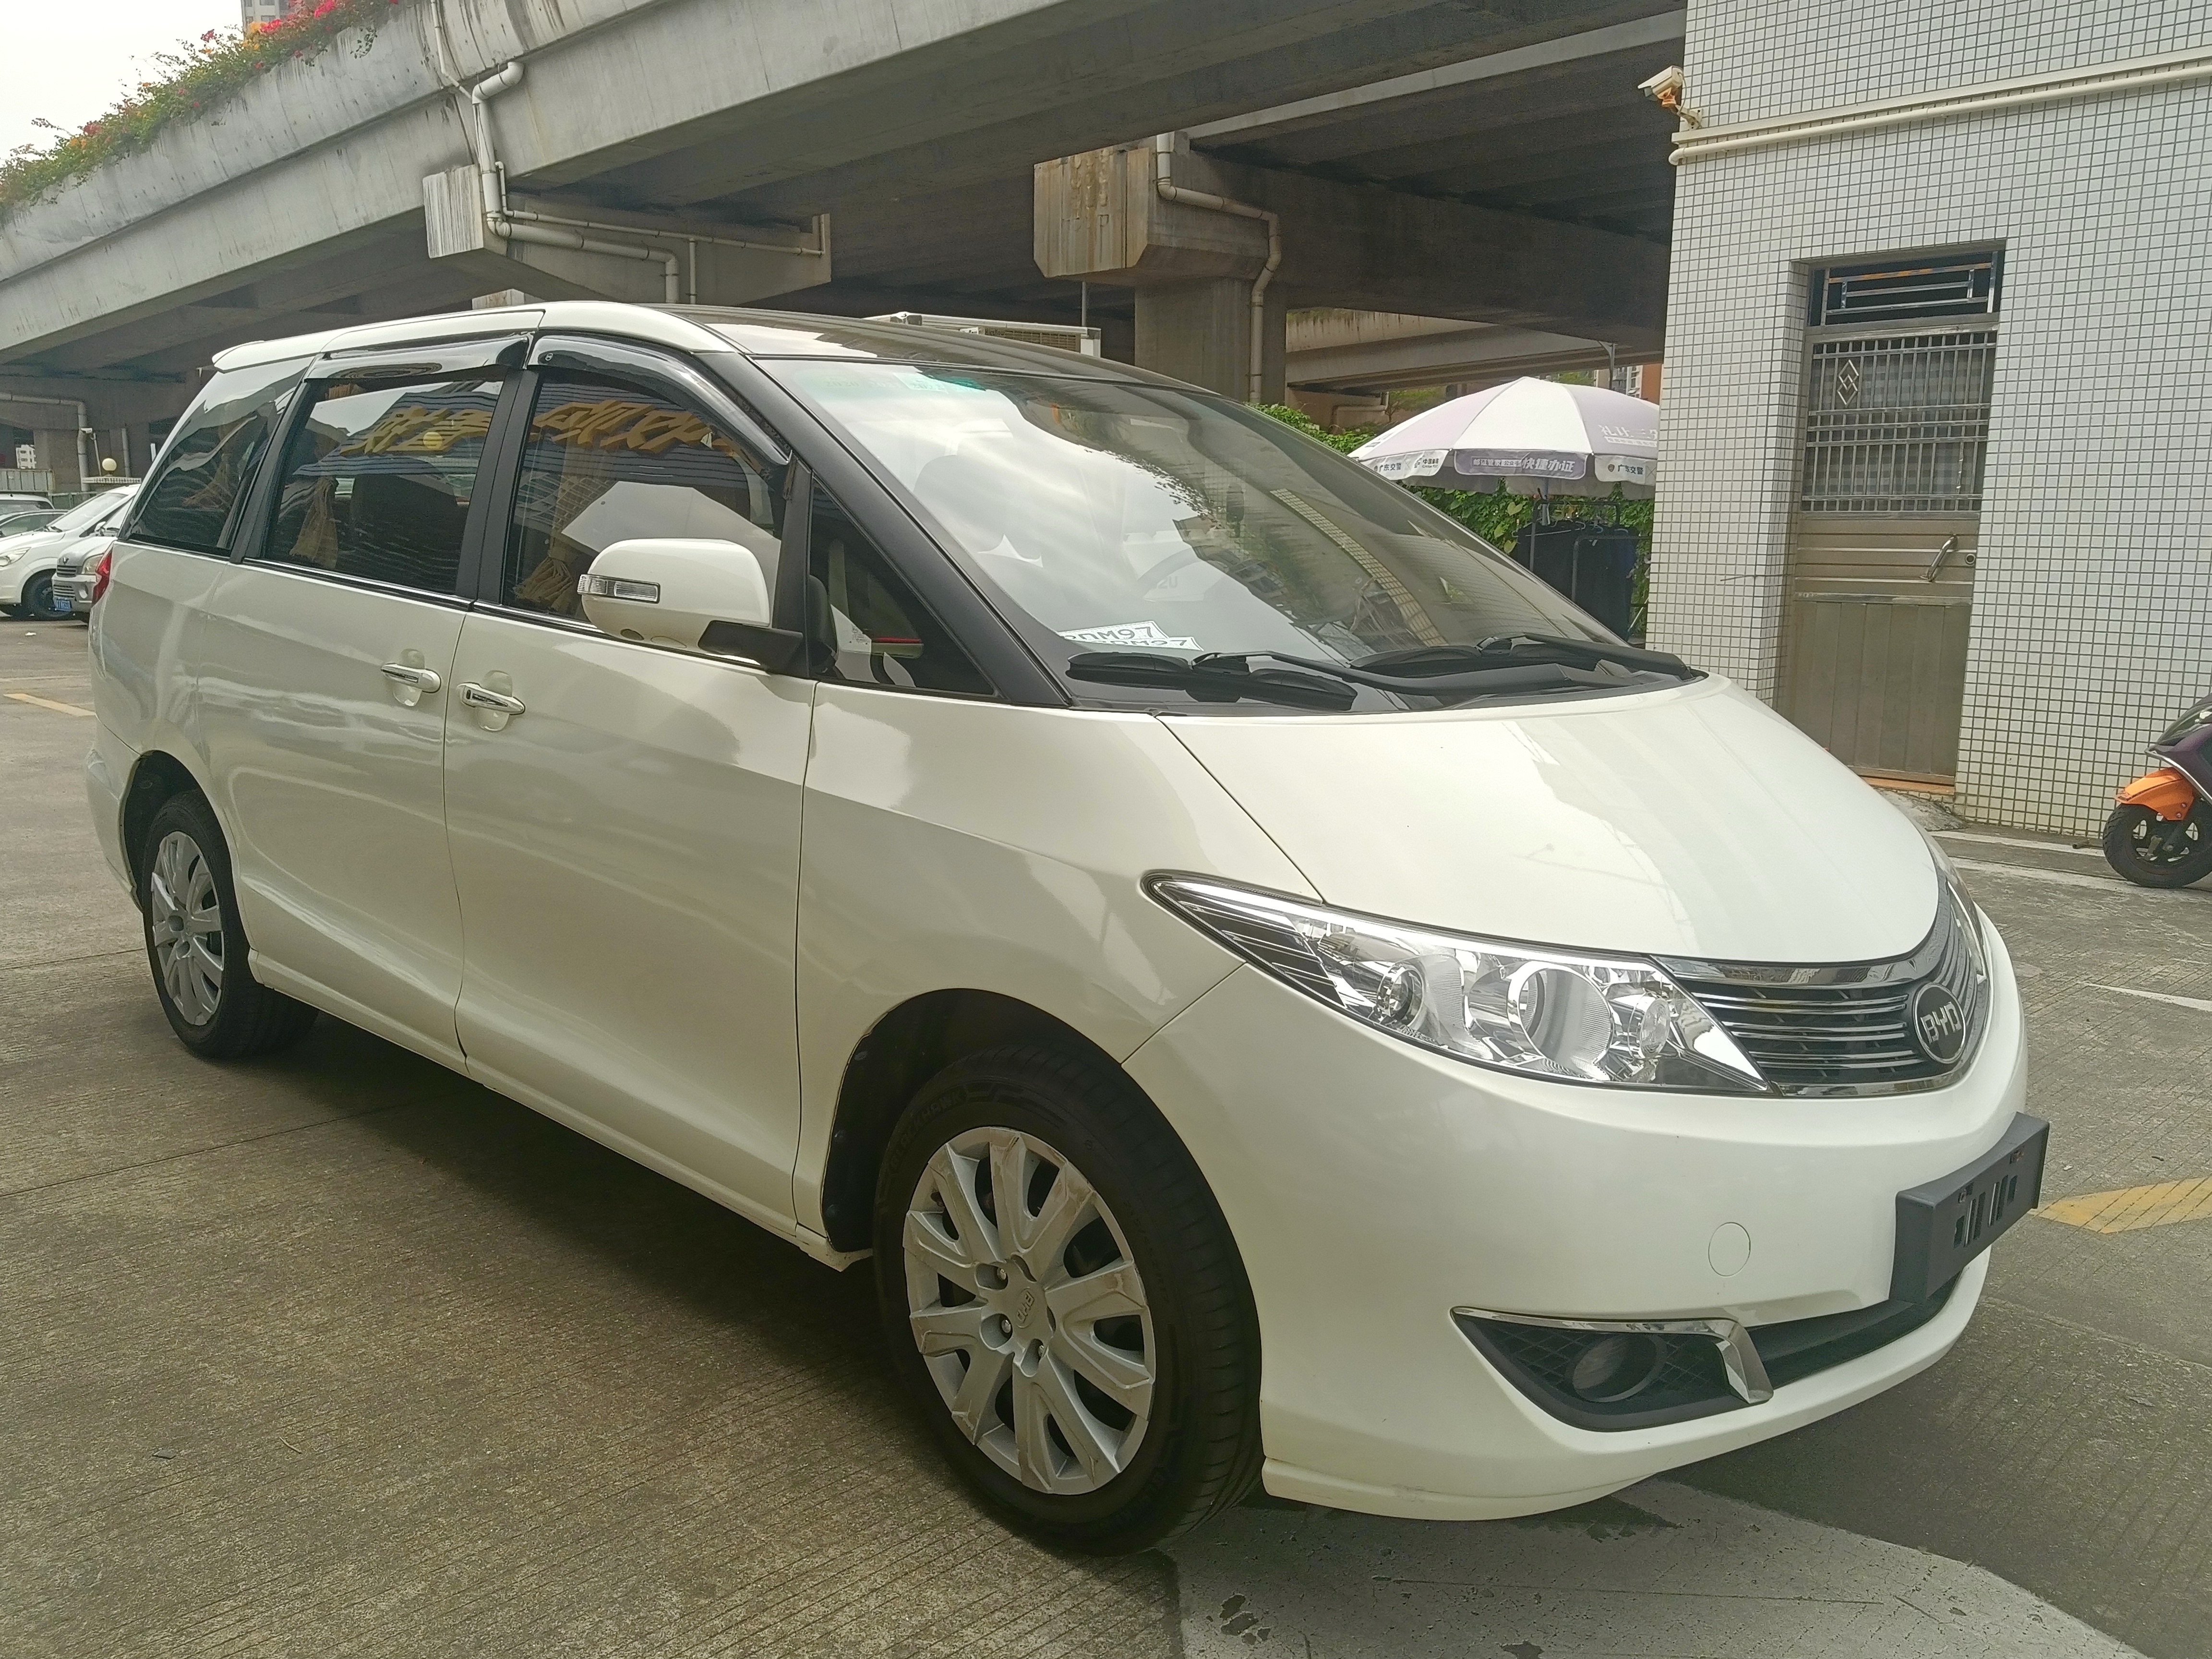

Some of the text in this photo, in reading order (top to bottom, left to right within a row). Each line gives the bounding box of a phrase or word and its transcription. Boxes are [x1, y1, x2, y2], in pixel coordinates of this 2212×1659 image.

[1379, 462, 1402, 472] 广东交警
[1522, 457, 1576, 473] 快捷办证
[1617, 463, 1644, 475] 广东交警
[1920, 1001, 1962, 1045] BYD
[1016, 1290, 1035, 1324] BYD
